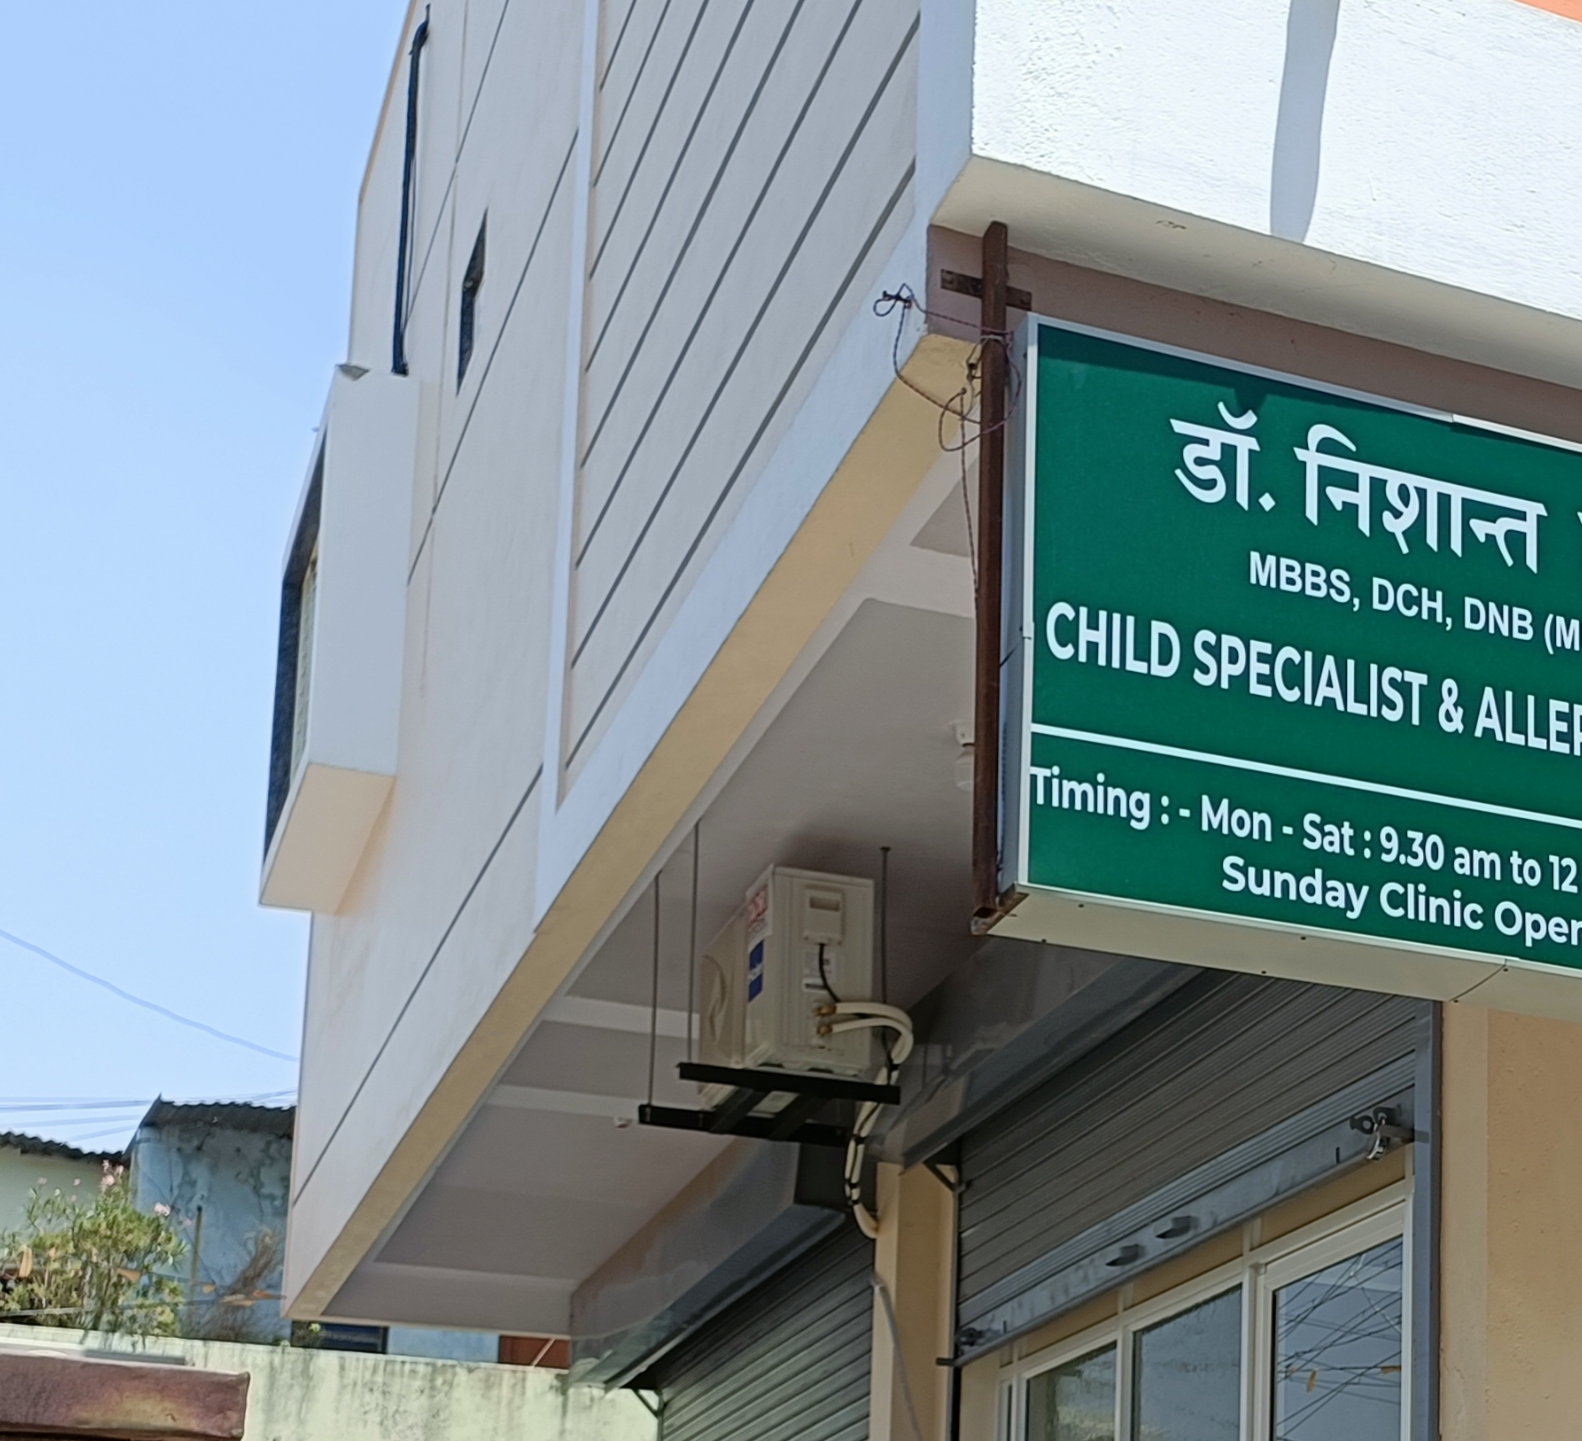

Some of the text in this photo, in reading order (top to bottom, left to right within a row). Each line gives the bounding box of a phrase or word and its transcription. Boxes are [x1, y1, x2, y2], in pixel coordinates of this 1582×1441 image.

[1169, 401, 1276, 512] डॉ.
[1293, 424, 1548, 574] निशान्त
[1250, 551, 1360, 612] MBBS,
[1372, 576, 1452, 631] DCH,
[1464, 596, 1534, 641] DNB
[1046, 601, 1181, 678] CHILD
[1193, 629, 1428, 726] SPECIALIST
[1438, 678, 1464, 734] &
[1030, 765, 1150, 830] Timing
[1201, 794, 1272, 842] Mon
[1303, 813, 1355, 856] Sat
[1379, 826, 1445, 870] 9.30
[1453, 846, 1501, 881] am
[1509, 850, 1542, 887] to
[1548, 854, 1578, 894] 12
[1222, 855, 1370, 919] Sunday
[1379, 882, 1484, 930] Clinic
